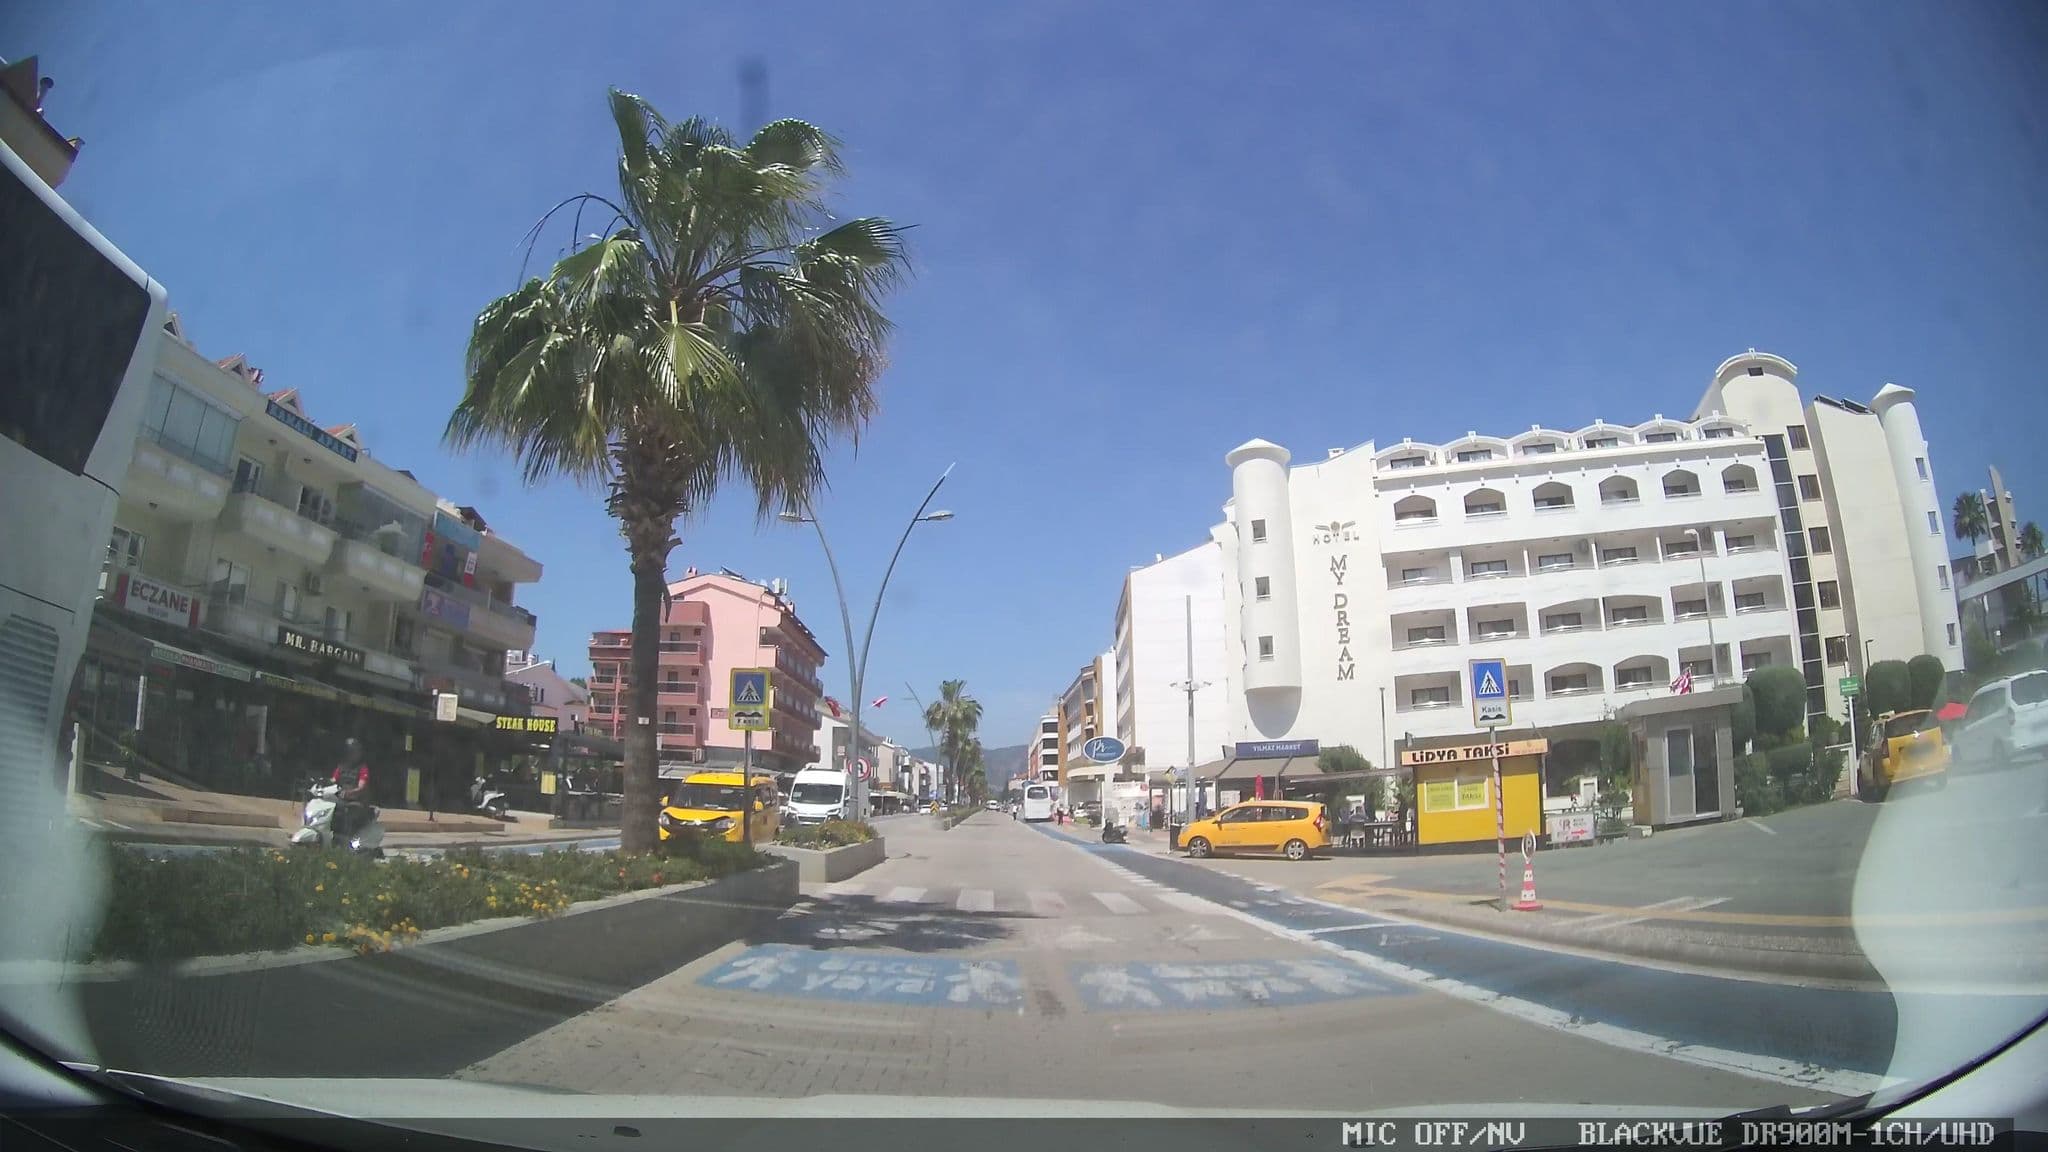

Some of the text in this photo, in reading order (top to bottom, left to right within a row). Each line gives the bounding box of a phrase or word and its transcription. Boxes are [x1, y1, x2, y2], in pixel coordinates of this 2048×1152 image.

[1313, 530, 1360, 545] HOTEL
[131, 581, 189, 613] ECZANE
[284, 631, 306, 650] MR.
[1334, 593, 1355, 681] DREAM
[496, 716, 556, 732] STEAK HOUSE
